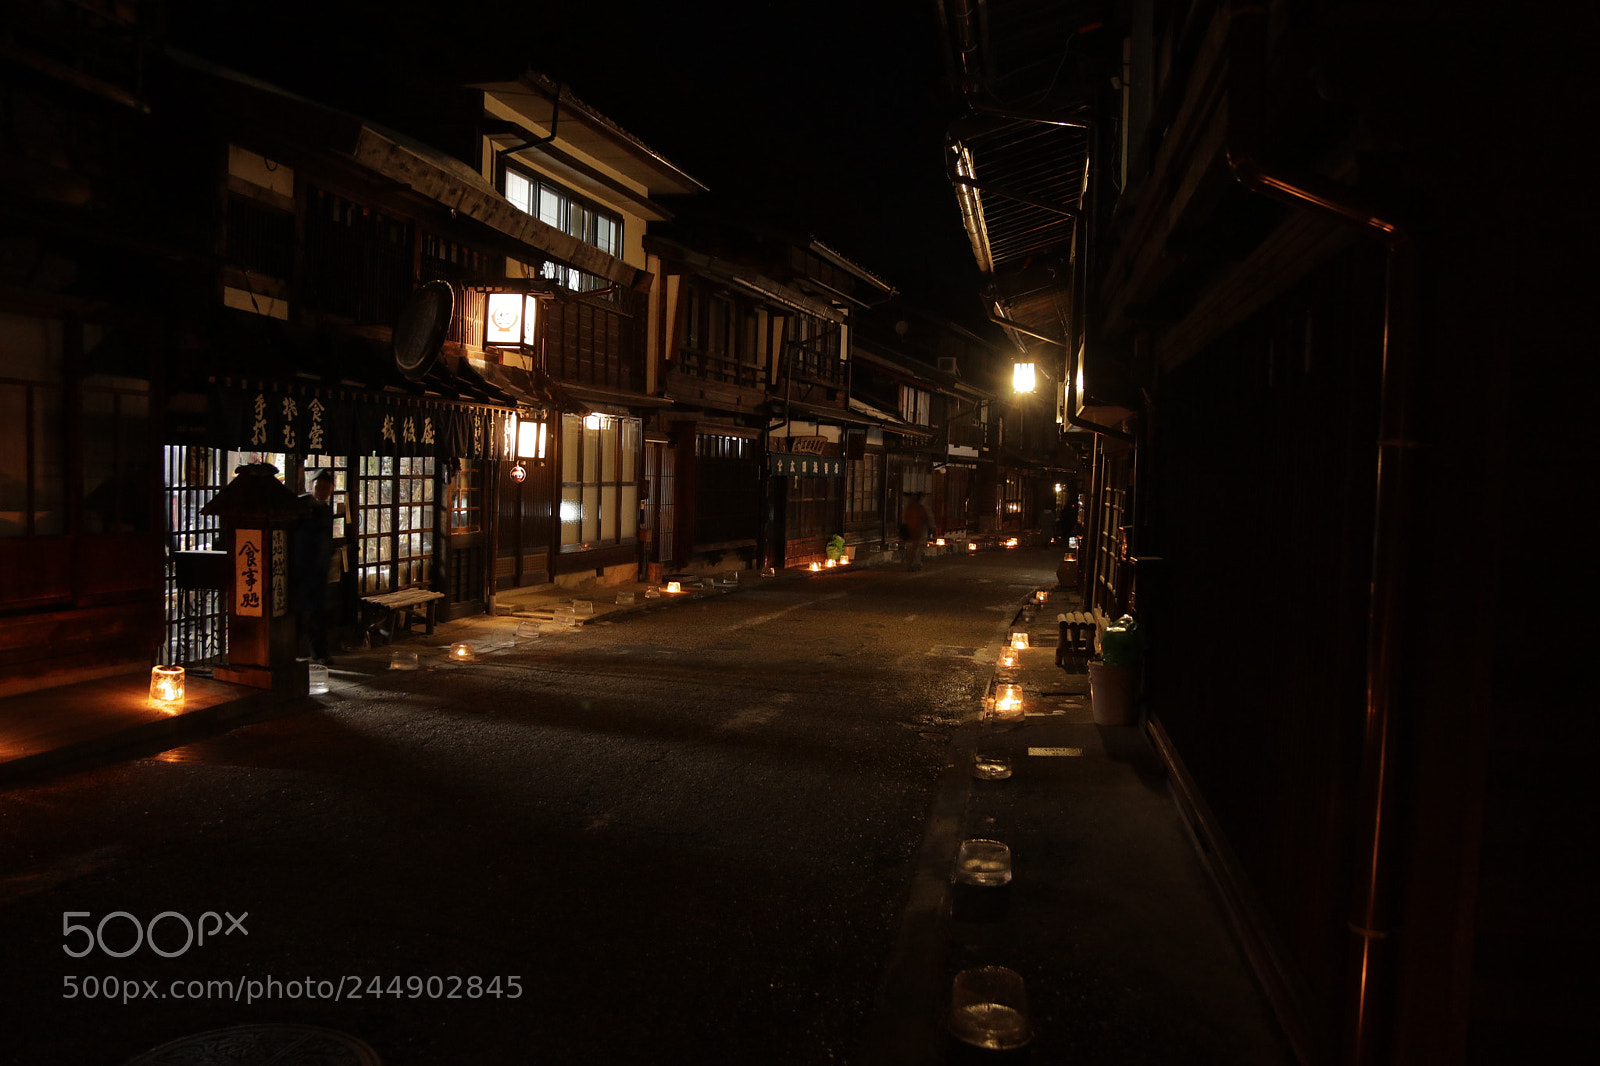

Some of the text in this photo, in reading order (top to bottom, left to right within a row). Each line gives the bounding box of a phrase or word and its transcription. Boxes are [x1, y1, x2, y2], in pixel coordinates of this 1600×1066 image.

[307, 397, 325, 449] 食堂
[238, 541, 259, 608] 食事処
